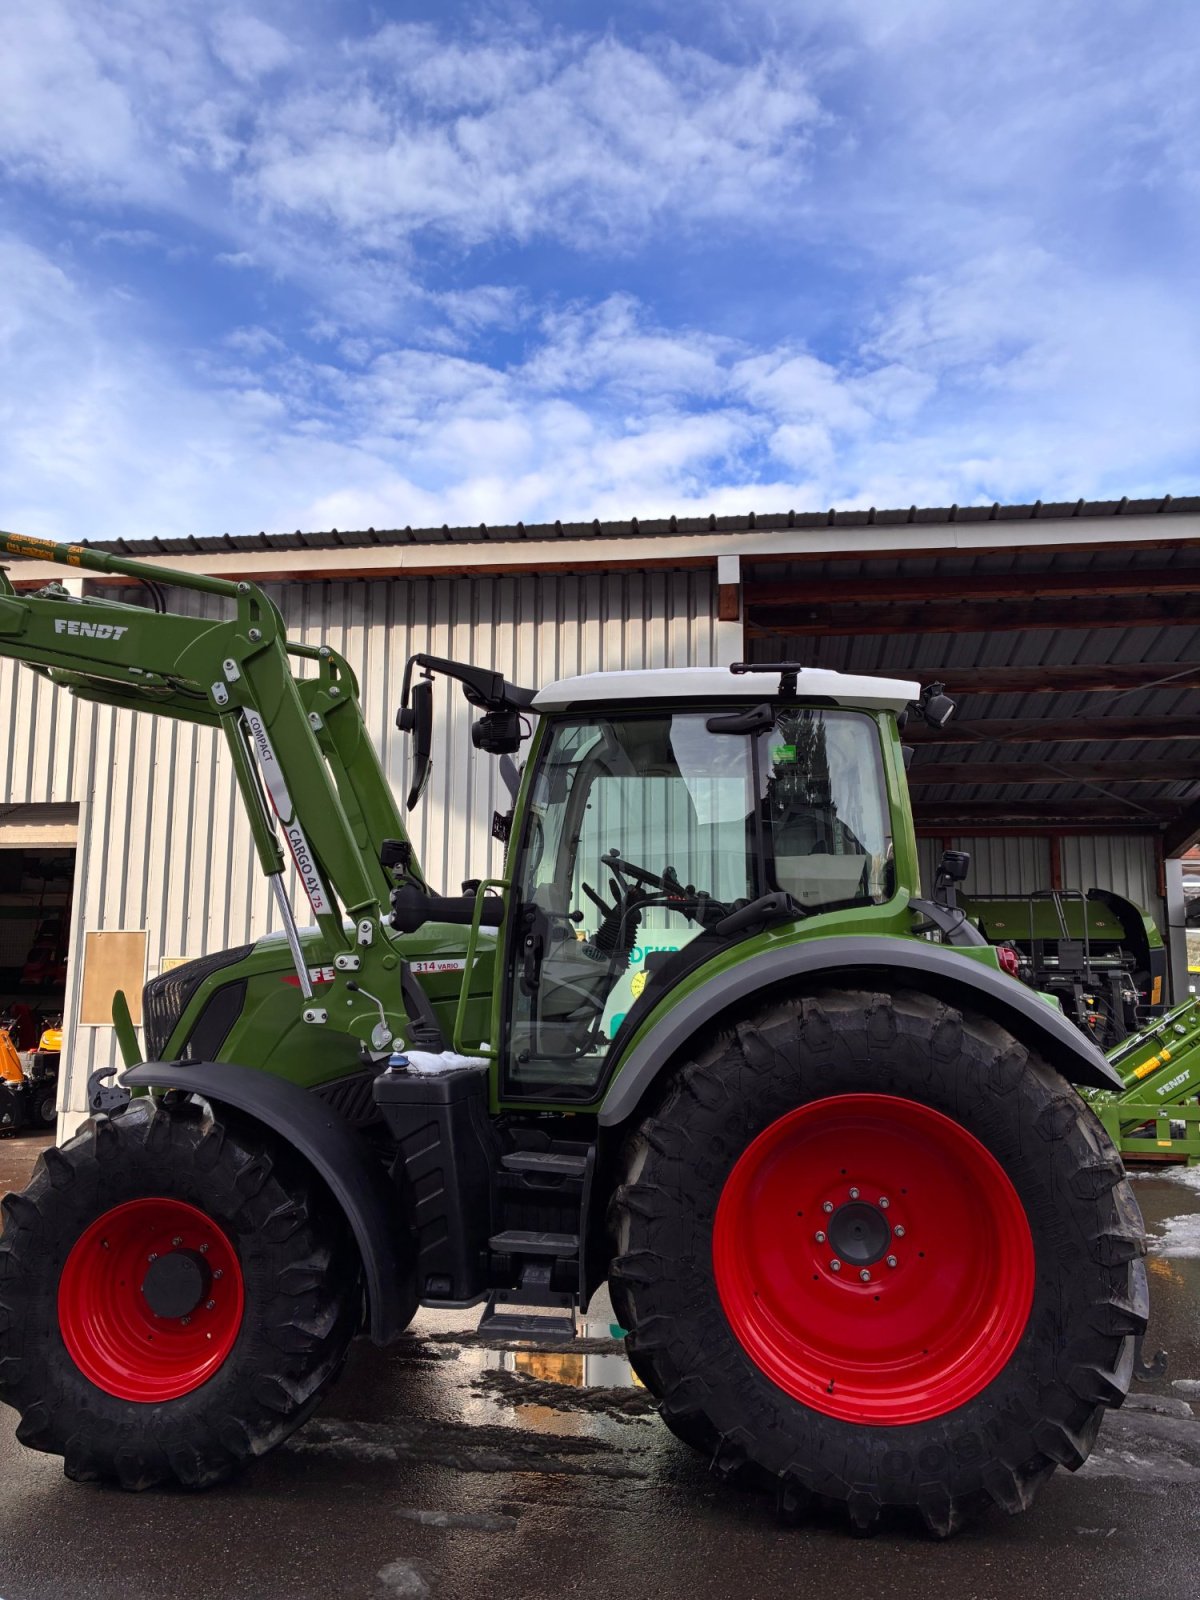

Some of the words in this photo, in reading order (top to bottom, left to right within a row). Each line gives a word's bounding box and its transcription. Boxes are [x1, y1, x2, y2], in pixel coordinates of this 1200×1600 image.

[54, 619, 128, 640] FENDT
[250, 717, 274, 762] COMPACT
[289, 829, 312, 875] CARGO
[306, 876, 321, 893] 4X
[313, 894, 324, 909] 75
[416, 962, 436, 972] 314
[437, 962, 459, 970] VARIO
[1156, 1069, 1191, 1096] FENDT
